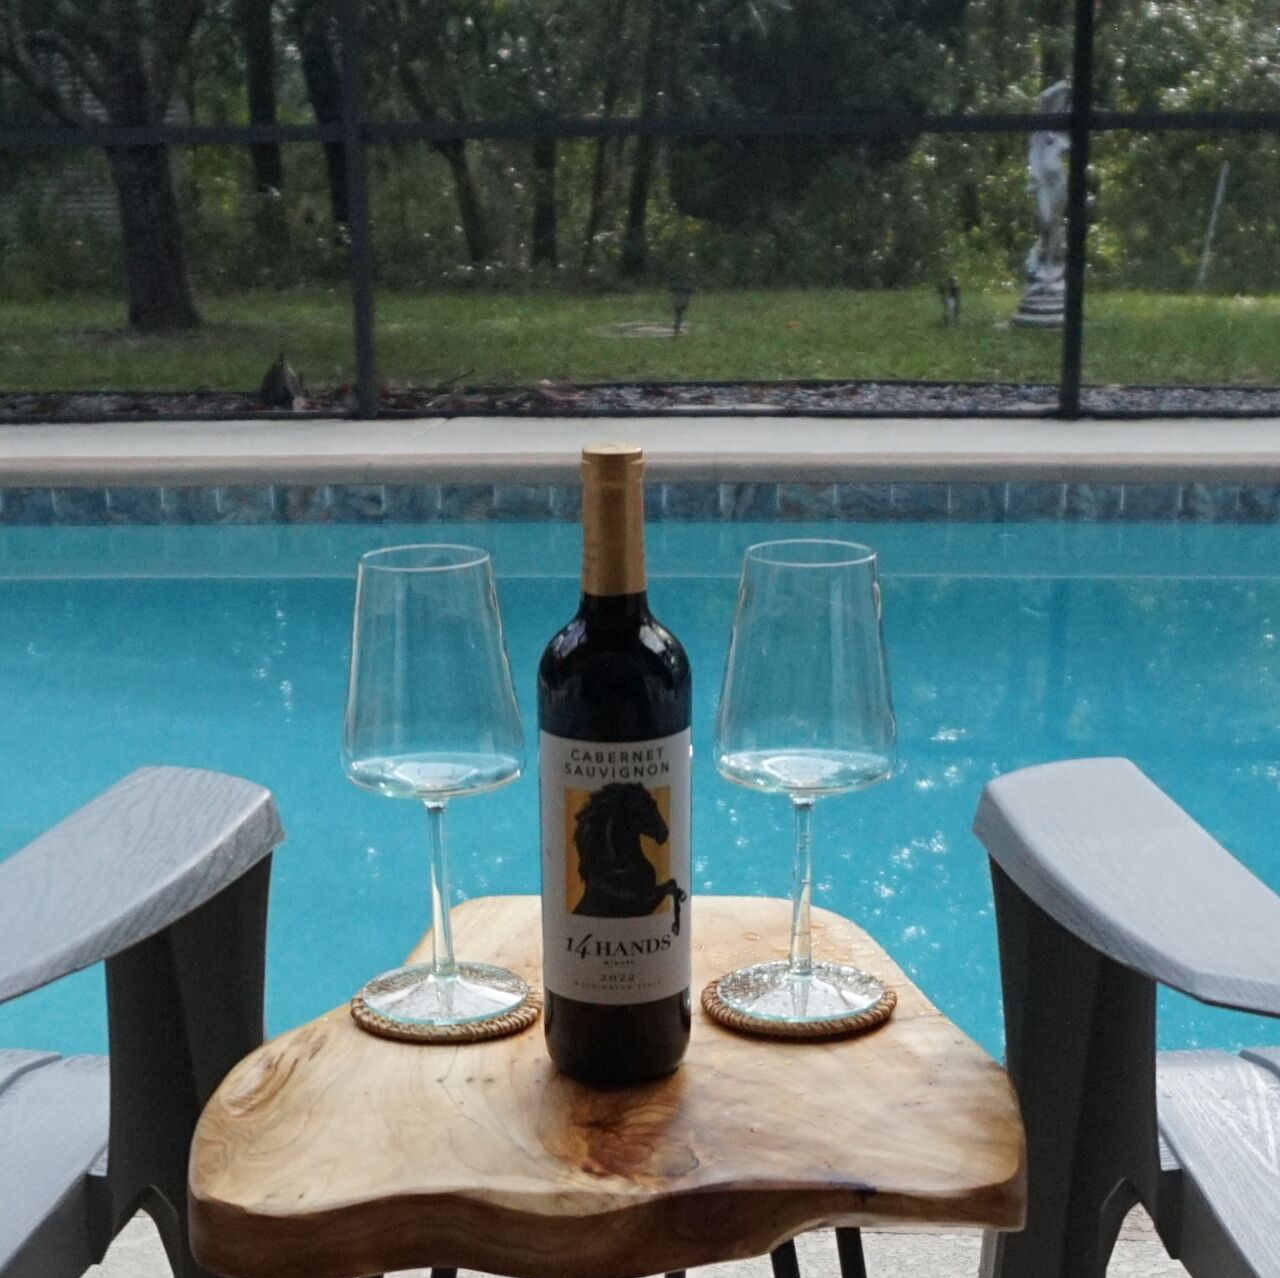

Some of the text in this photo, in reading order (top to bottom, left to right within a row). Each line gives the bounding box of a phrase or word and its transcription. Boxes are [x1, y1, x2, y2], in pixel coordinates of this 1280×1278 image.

[570, 746, 664, 764] CABERNET
[565, 760, 670, 779] SAUVIGNON
[566, 933, 671, 959] 14 HANDS
